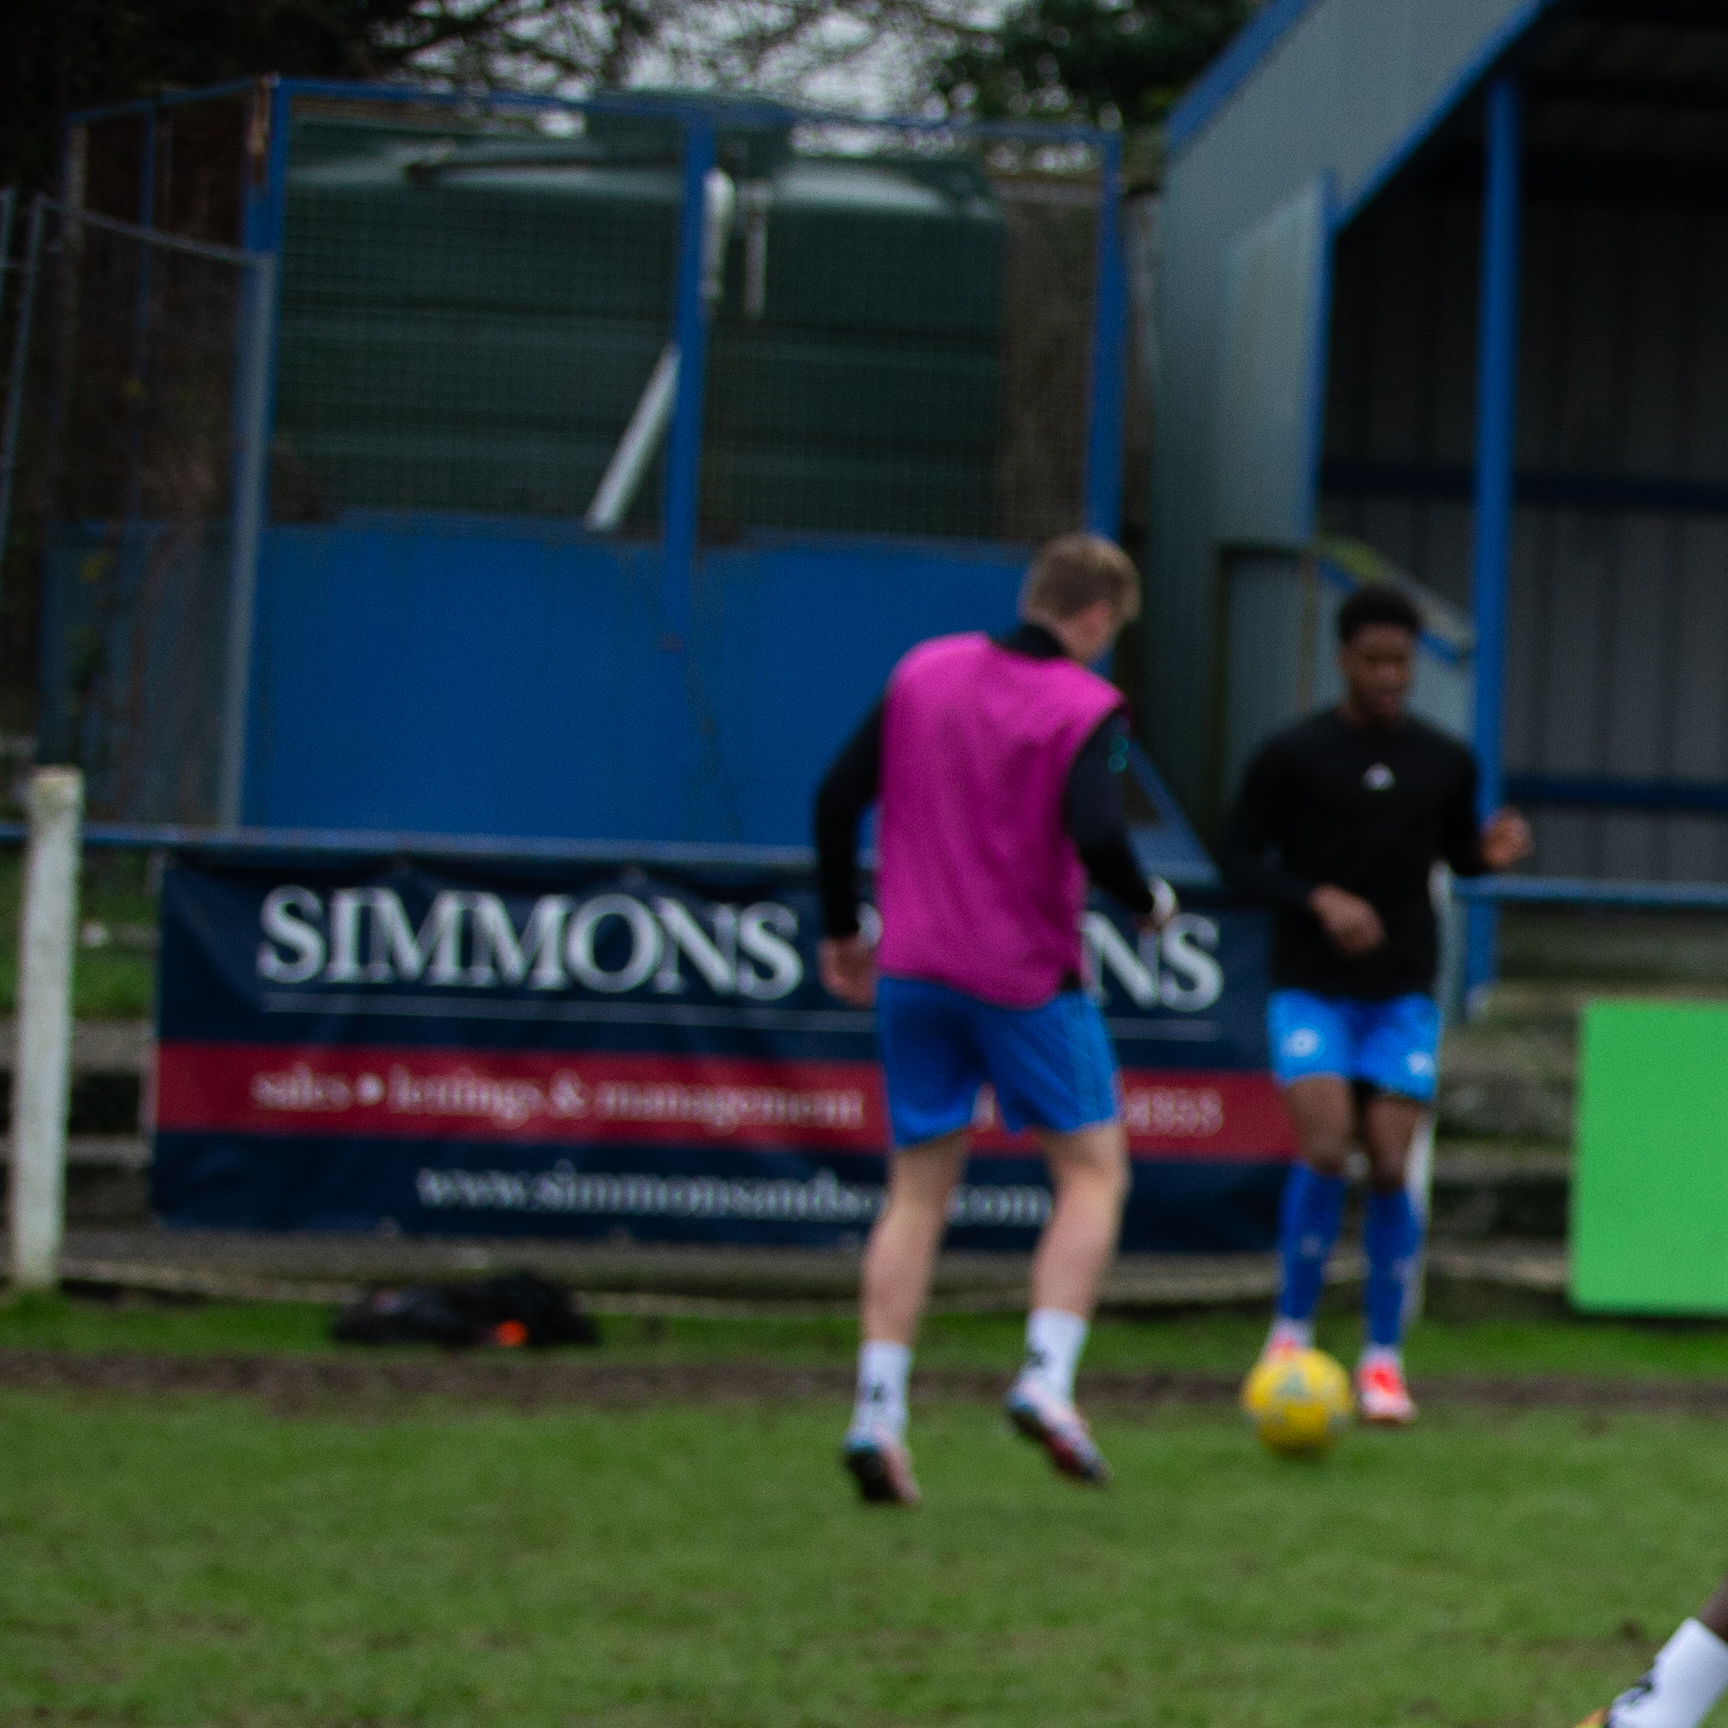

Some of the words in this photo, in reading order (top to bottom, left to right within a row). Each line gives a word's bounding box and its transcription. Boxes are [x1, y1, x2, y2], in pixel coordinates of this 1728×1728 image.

[257, 884, 802, 1000] SIMMONS
[1078, 909, 1225, 1013] NS
[387, 1063, 545, 1131] lettings
[550, 1068, 592, 1121] &
[595, 1079, 865, 1138] management
